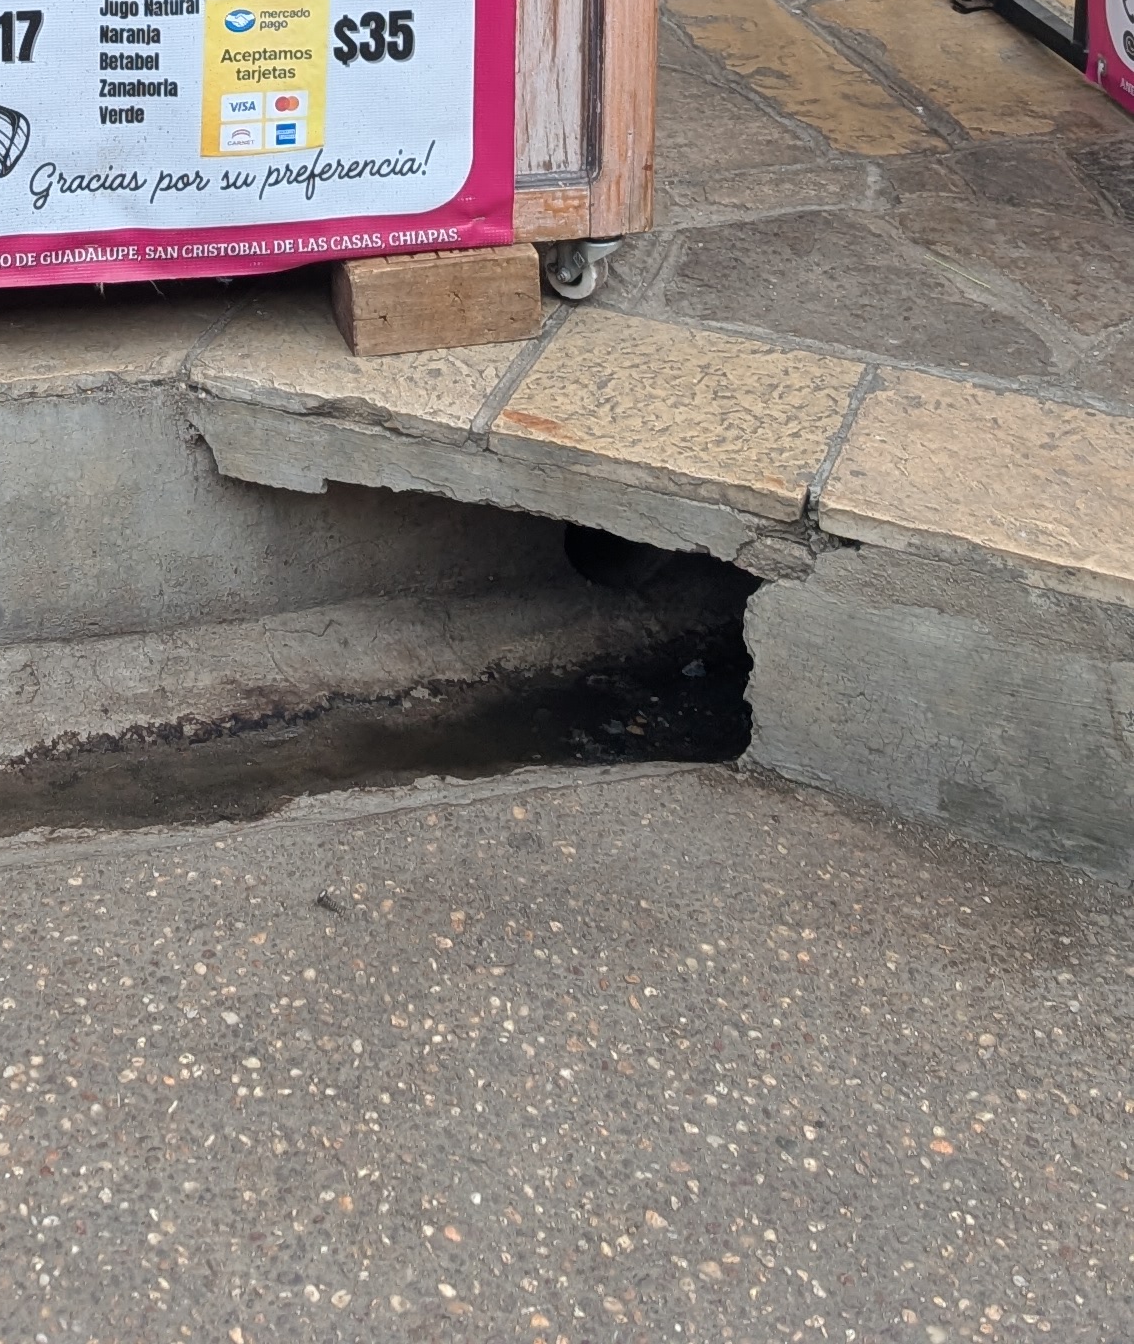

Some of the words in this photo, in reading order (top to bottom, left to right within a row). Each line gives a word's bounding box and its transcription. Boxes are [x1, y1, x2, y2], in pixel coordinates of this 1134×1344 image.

[100, 0, 138, 19] Jugo
[259, 7, 311, 19] mercado
[259, 19, 289, 32] pago
[100, 25, 160, 45] Naranja
[334, 10, 413, 65] $35
[100, 53, 159, 70] Betabel
[220, 47, 313, 65] Aceptamos
[235, 65, 297, 84] tarjetas
[99, 79, 177, 97] Zanahoria
[100, 106, 144, 124] Verde
[229, 100, 257, 113] VISA
[30, 163, 146, 209] Gracias
[150, 171, 210, 203] por
[221, 171, 255, 190] su
[259, 141, 435, 200] preferencia!
[16, 253, 36, 266] DE
[41, 247, 141, 264] GUADALUPE,
[146, 246, 177, 258] SAN
[182, 242, 270, 257] CRISTOBAL
[274, 240, 294, 253] DE
[298, 238, 327, 251] LAS
[331, 234, 385, 249] CASAS,
[389, 228, 463, 245] CHIAPAS.
